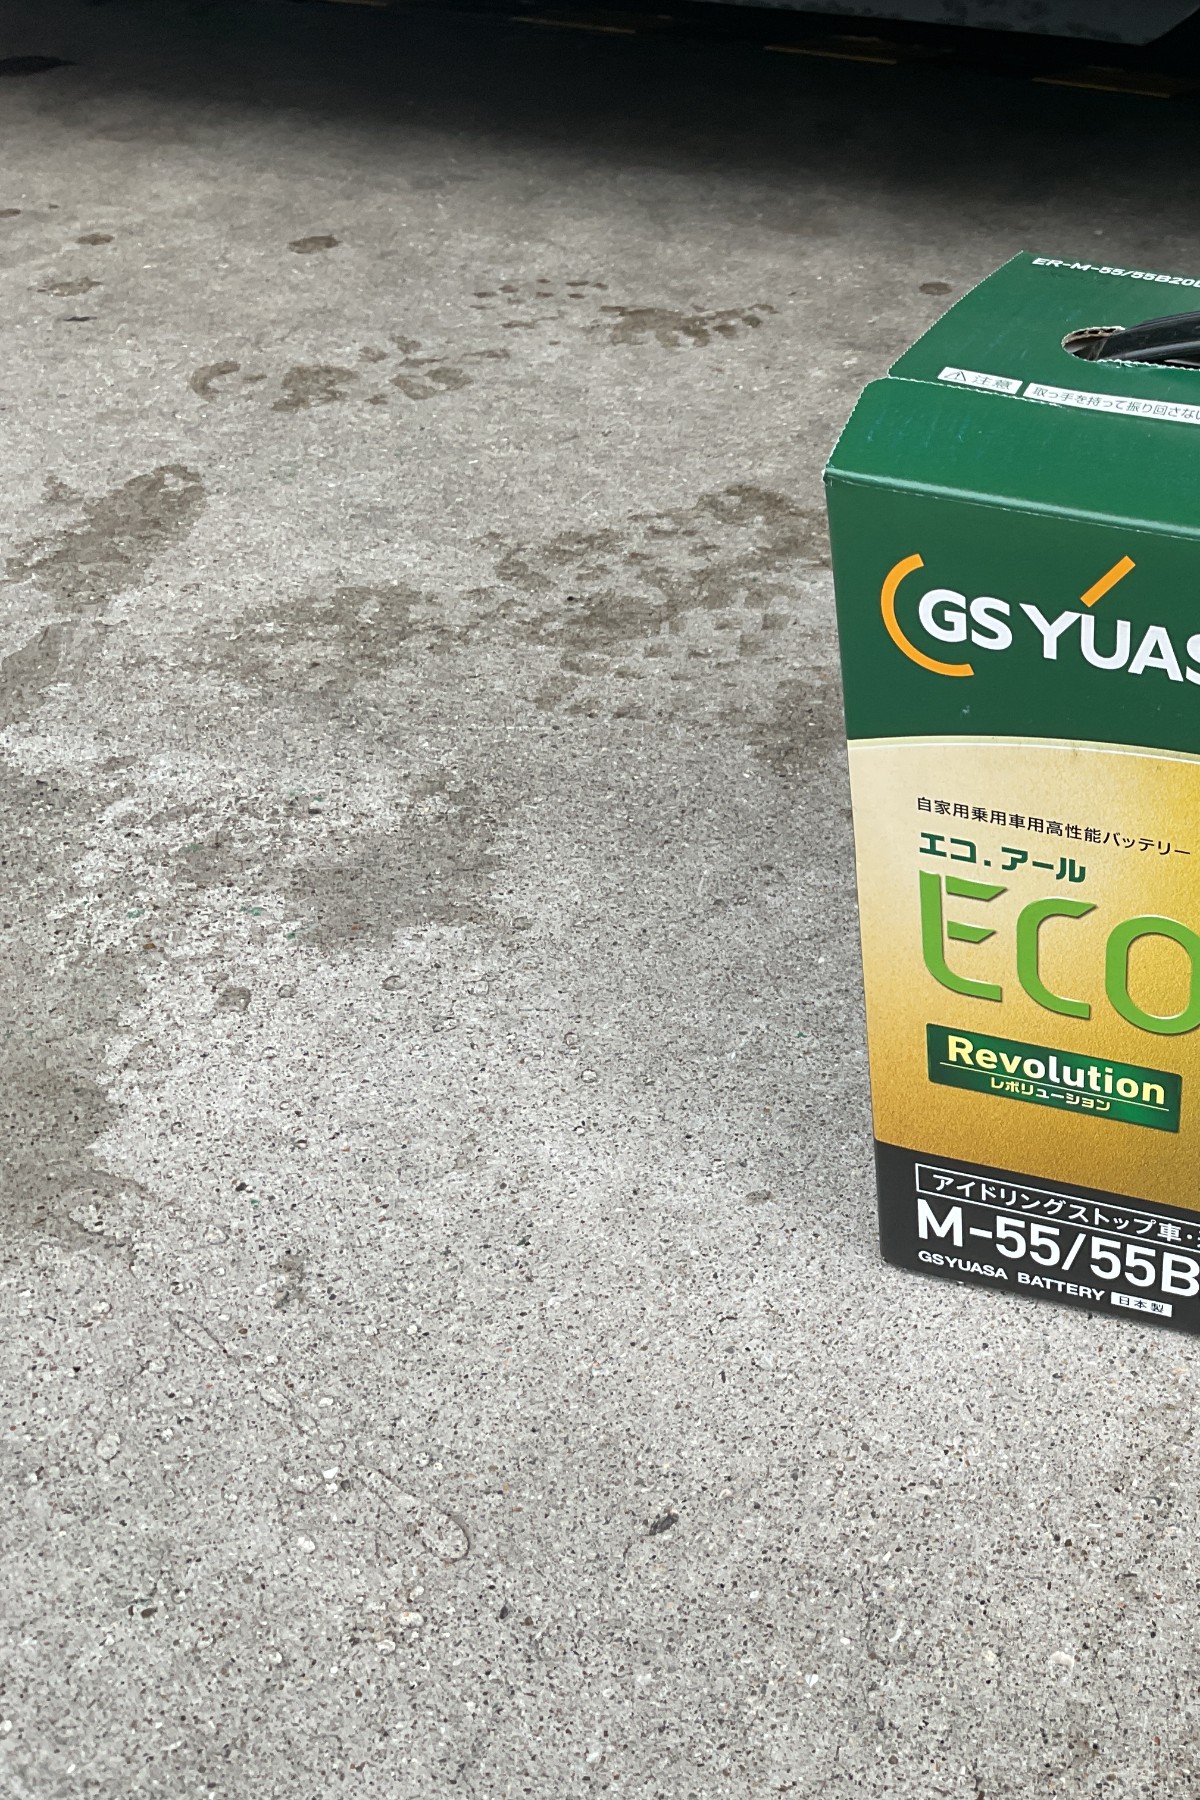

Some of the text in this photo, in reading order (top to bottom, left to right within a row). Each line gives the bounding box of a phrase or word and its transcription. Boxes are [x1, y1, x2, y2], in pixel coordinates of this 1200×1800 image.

[972, 373, 1013, 390] 注意
[916, 796, 1191, 856] 自家用乗用車用高性能バッテリー
[947, 1034, 1165, 1105] Revolution
[990, 1076, 1111, 1112] レボリューション
[1017, 1272, 1106, 1301] BATTERY
[1118, 1295, 1165, 1314] 日本製
